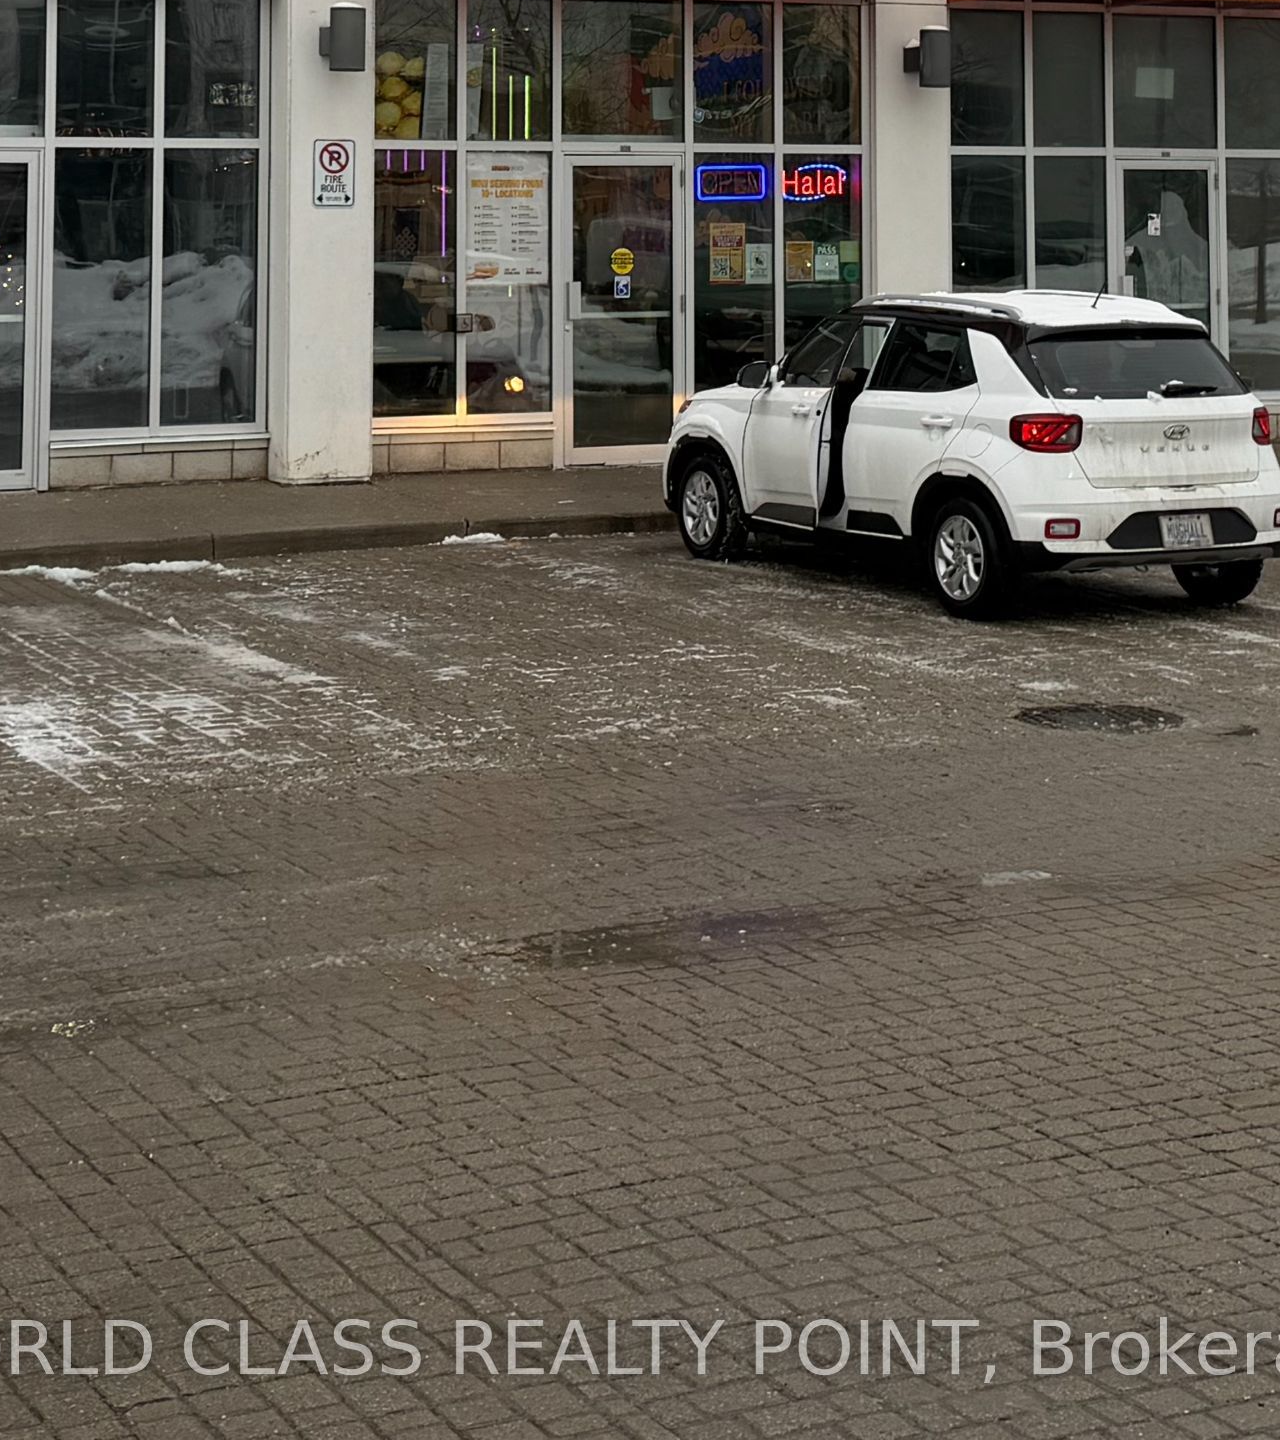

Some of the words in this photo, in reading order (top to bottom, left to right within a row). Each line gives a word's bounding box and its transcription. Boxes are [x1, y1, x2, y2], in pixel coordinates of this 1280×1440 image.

[325, 175, 344, 184] FIRE
[702, 171, 761, 194] OPEN
[782, 170, 843, 195] Halal
[321, 184, 347, 193] ROUTE
[817, 245, 837, 255] PASS
